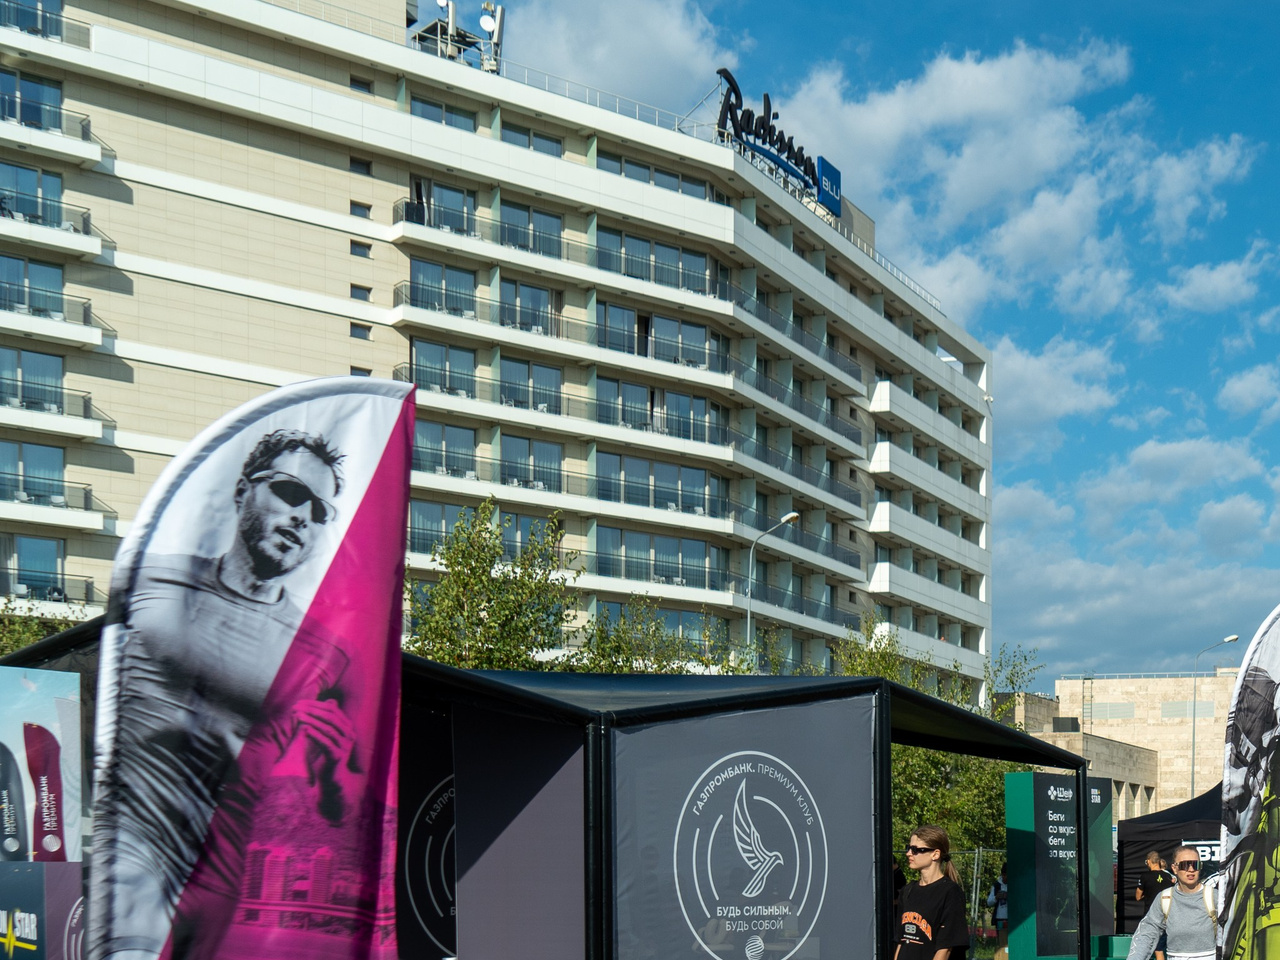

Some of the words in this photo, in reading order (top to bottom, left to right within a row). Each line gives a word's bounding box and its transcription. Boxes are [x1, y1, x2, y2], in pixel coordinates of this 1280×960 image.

[822, 175, 841, 200] BLU
[757, 763, 798, 797] ПРЕМИУМ
[796, 795, 814, 826] КЛУБ
[1048, 836, 1066, 846] беги
[716, 906, 741, 918] БУДЬ
[743, 906, 792, 916] СИЛЬНЫМ.
[14, 911, 38, 940] STAR
[725, 920, 749, 932] БУДЬ
[751, 918, 783, 931] СОБОЙ
